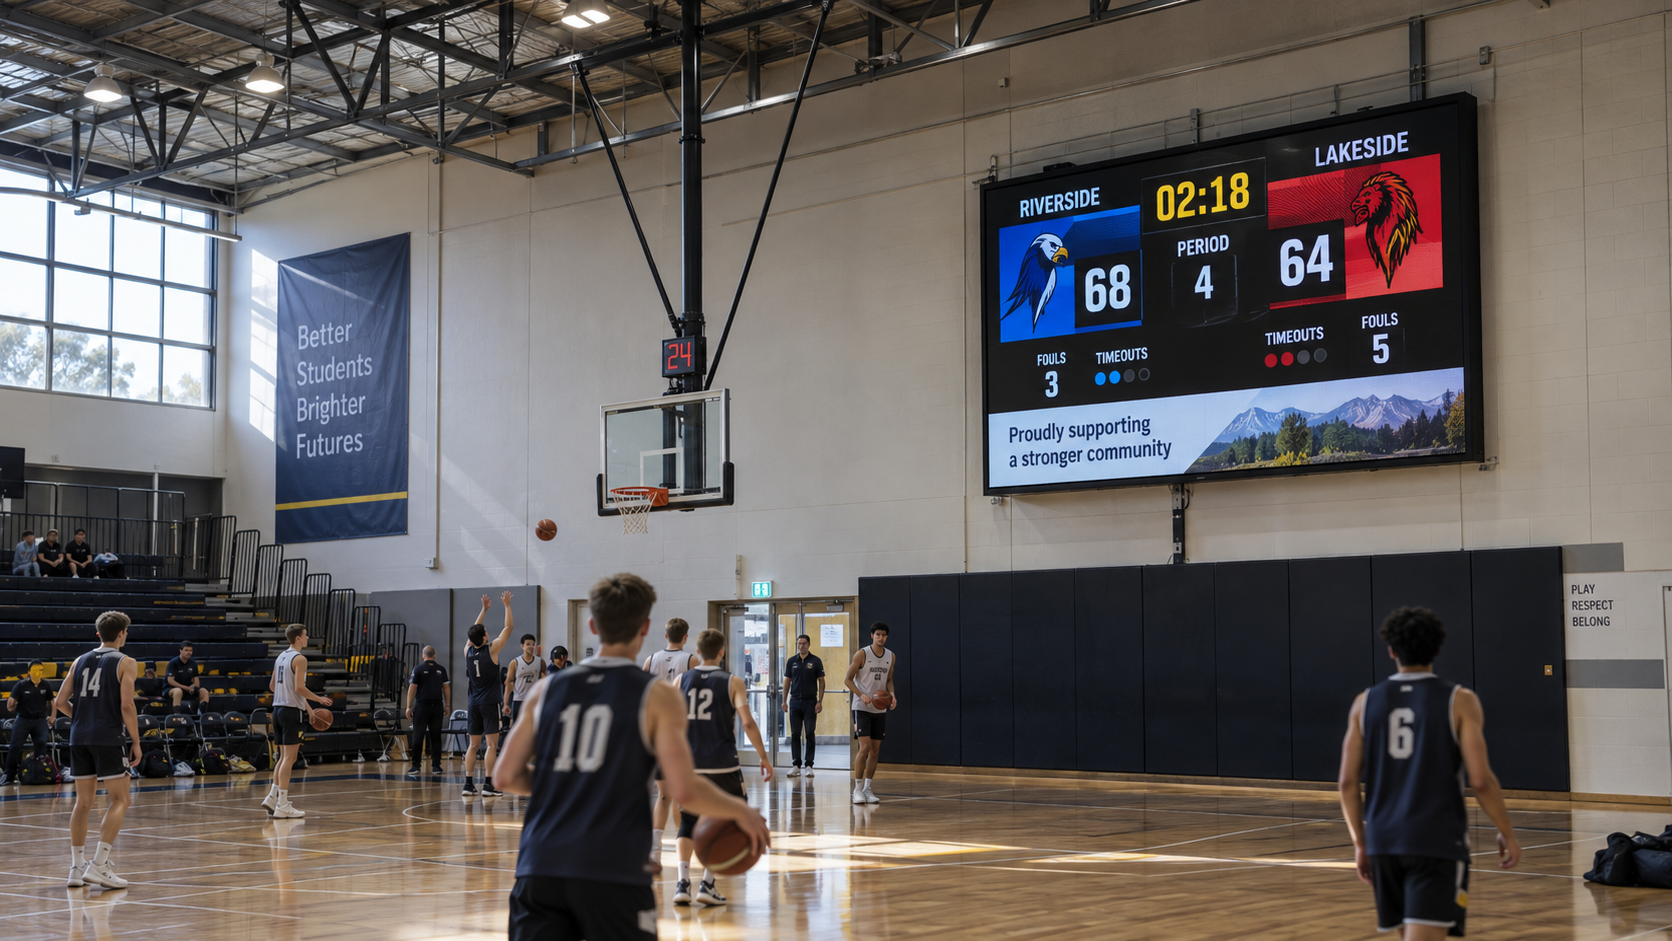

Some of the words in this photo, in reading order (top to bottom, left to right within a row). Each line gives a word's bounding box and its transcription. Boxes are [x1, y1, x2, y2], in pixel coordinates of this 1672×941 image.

[1315, 131, 1409, 167] LAKESIDE
[1019, 187, 1100, 218] RIVERSIDE
[1157, 172, 1250, 221] 02:18
[1178, 235, 1230, 258] PERIOD
[1280, 234, 1334, 287] 64
[1085, 264, 1131, 313] 68
[1194, 265, 1214, 300] 4
[1362, 312, 1399, 329] FOULS
[298, 322, 353, 350] Better
[1265, 327, 1324, 345] TIMEOUTS
[1373, 334, 1390, 364] 5
[297, 354, 373, 386] Students
[668, 342, 691, 369] 24
[1038, 352, 1067, 367] FOULS
[1096, 347, 1148, 364] TIMEOUTS
[1045, 371, 1059, 398] 3
[297, 393, 366, 424] Brighter
[1009, 423, 1065, 444] Proudly
[1069, 416, 1151, 441] supporting
[297, 432, 364, 459] Futures
[1009, 455, 1018, 468] a
[1022, 450, 1084, 469] stronger
[1087, 439, 1172, 463] community
[1571, 584, 1596, 595] PLAY
[1571, 599, 1614, 611] RESPECT
[1573, 616, 1611, 627] BELONG
[80, 667, 102, 697] 14
[474, 660, 481, 678] 1
[688, 687, 713, 721] 12
[554, 704, 613, 773] 10
[1388, 707, 1415, 759] 6
